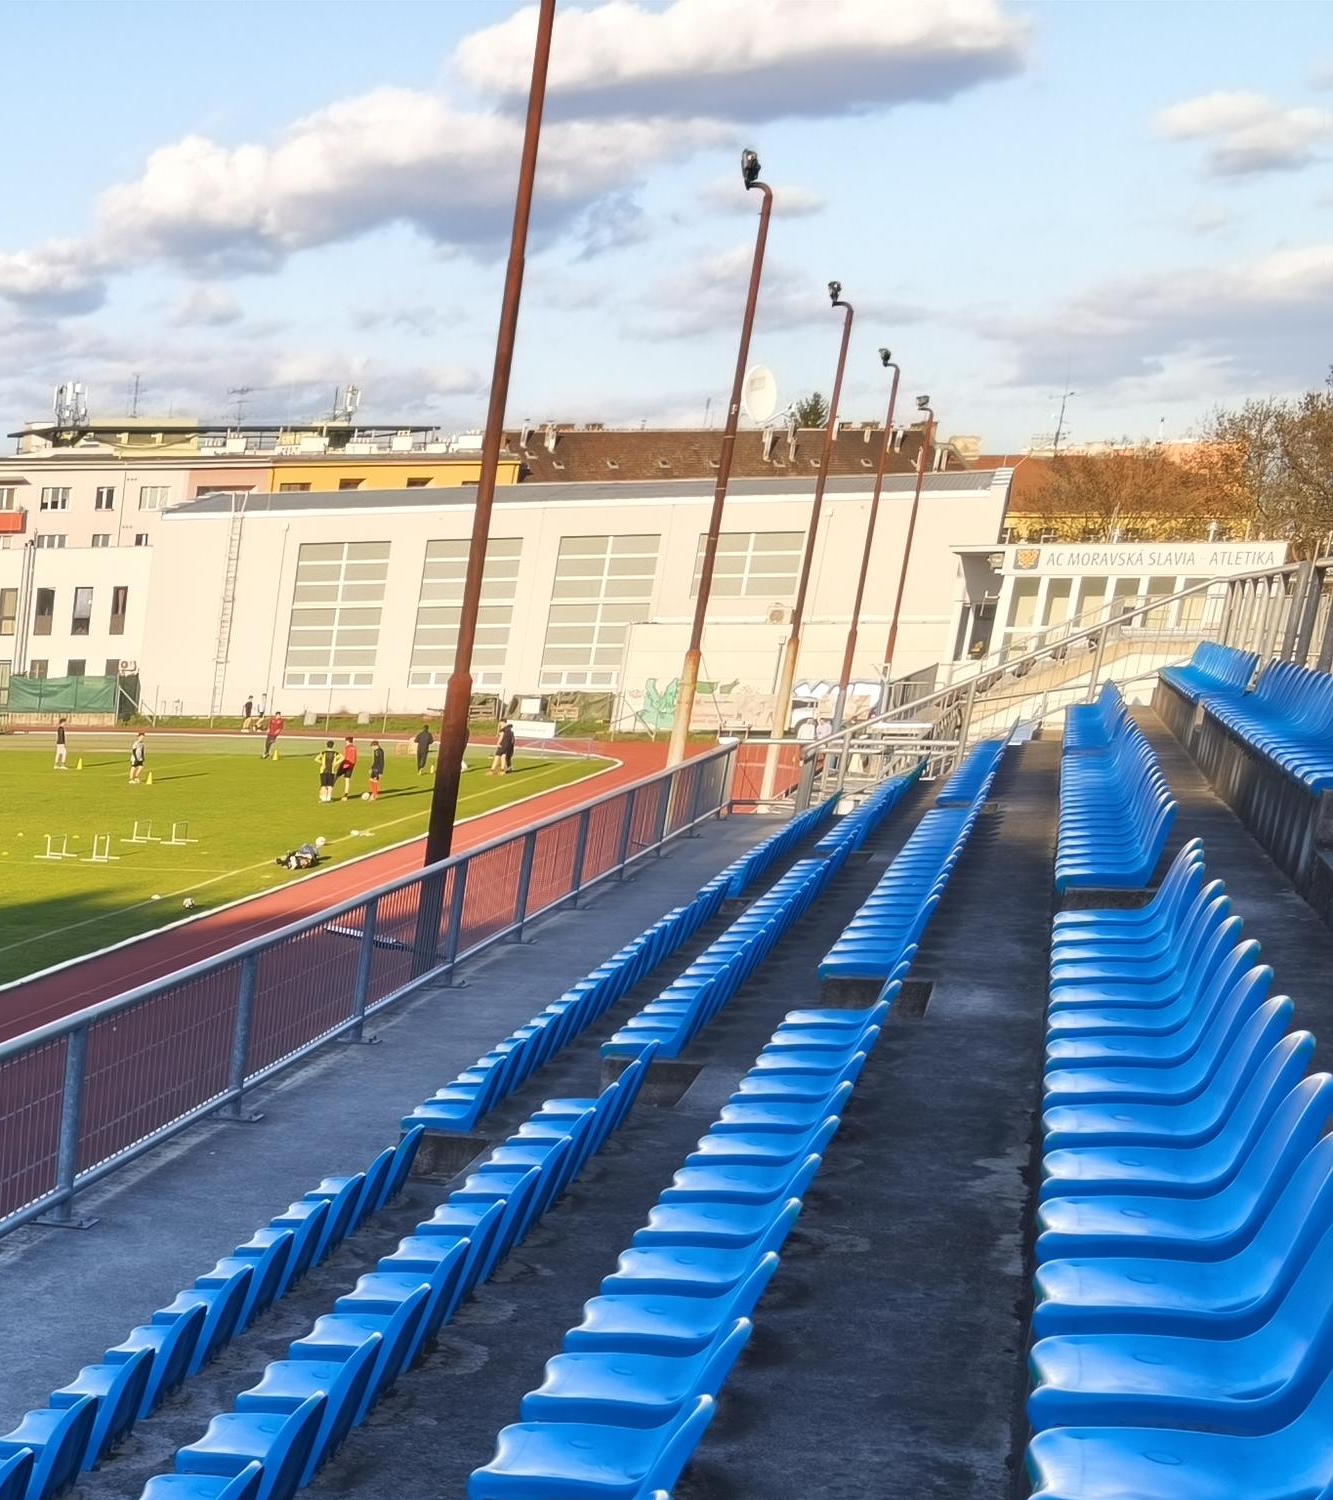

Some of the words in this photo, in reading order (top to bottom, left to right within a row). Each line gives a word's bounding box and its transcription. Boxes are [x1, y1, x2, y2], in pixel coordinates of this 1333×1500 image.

[1046, 552, 1064, 566] AC
[1067, 549, 1145, 566] MORAVSKÁ
[1148, 551, 1196, 566] SLAVIA
[1209, 551, 1275, 565] ATLETIKA
